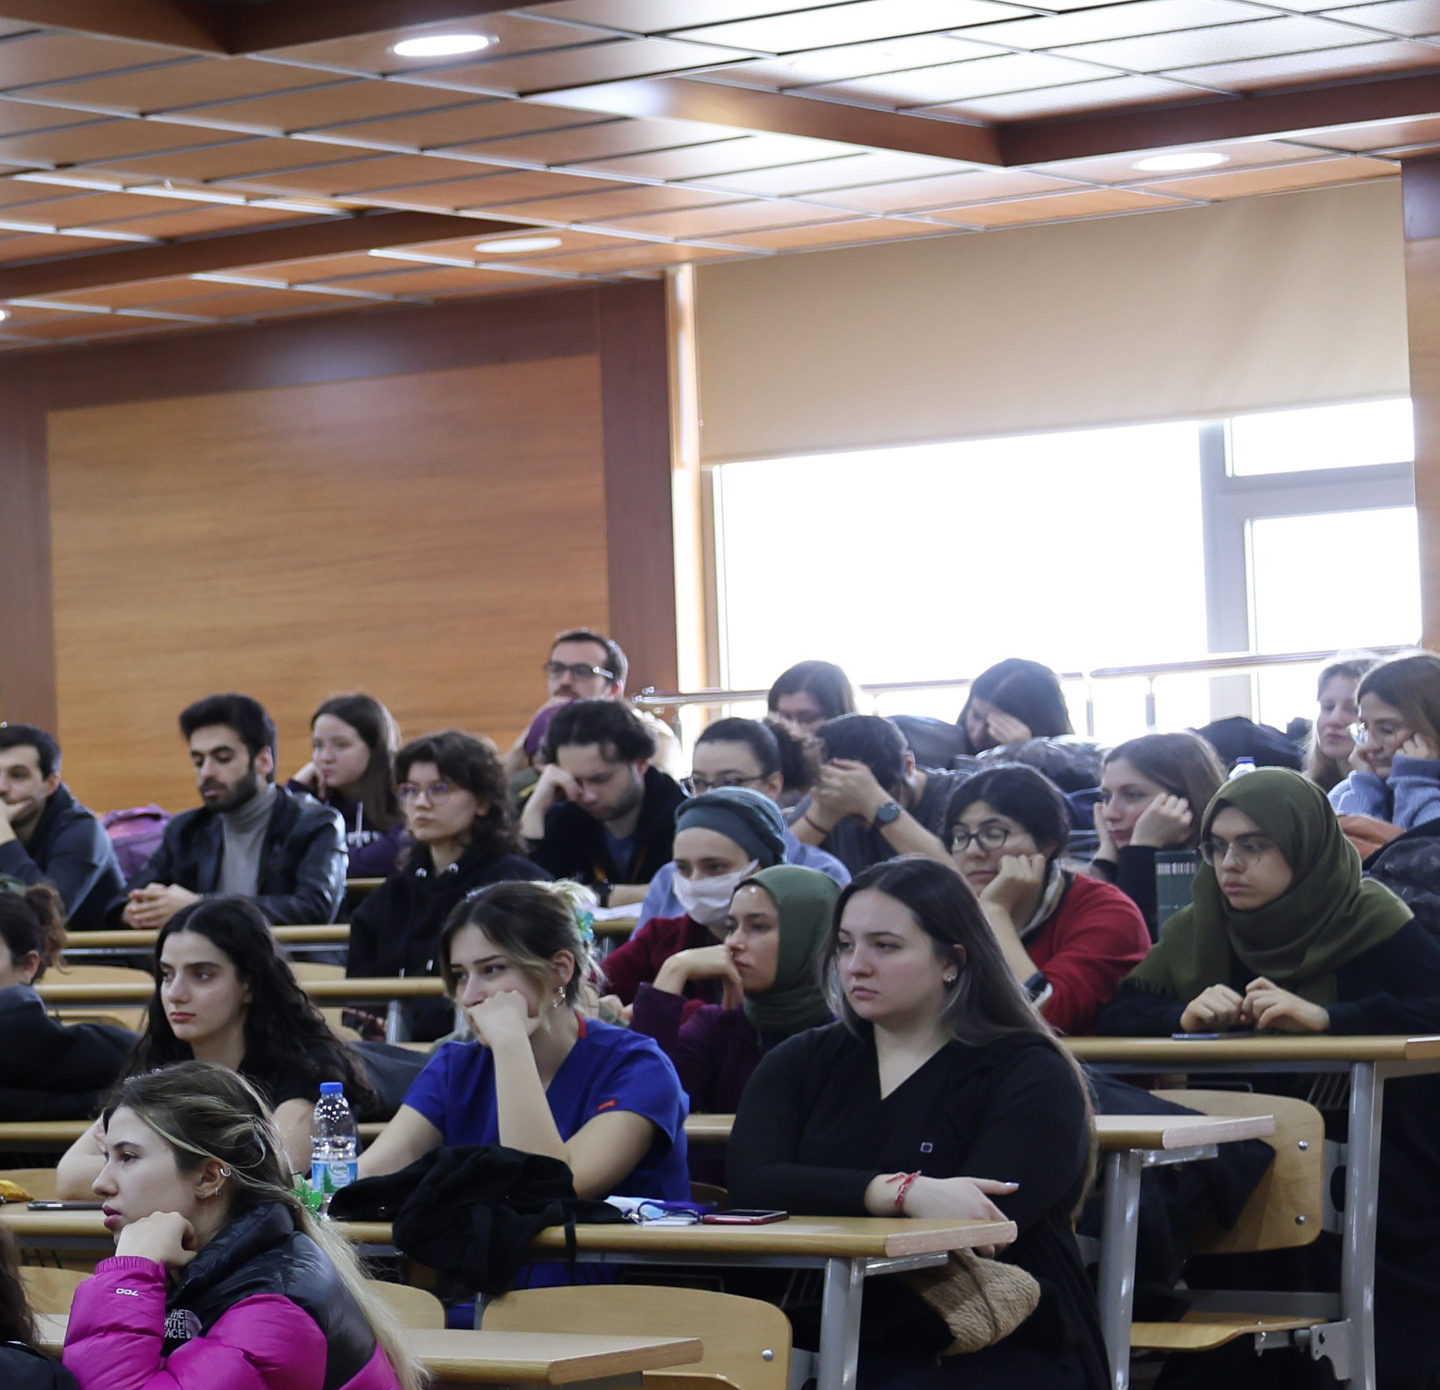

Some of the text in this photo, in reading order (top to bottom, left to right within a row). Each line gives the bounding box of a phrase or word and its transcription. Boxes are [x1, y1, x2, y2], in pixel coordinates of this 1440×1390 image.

[115, 1287, 140, 1297] 700
[164, 1317, 186, 1330] RTH
[164, 1328, 186, 1339] ACE
